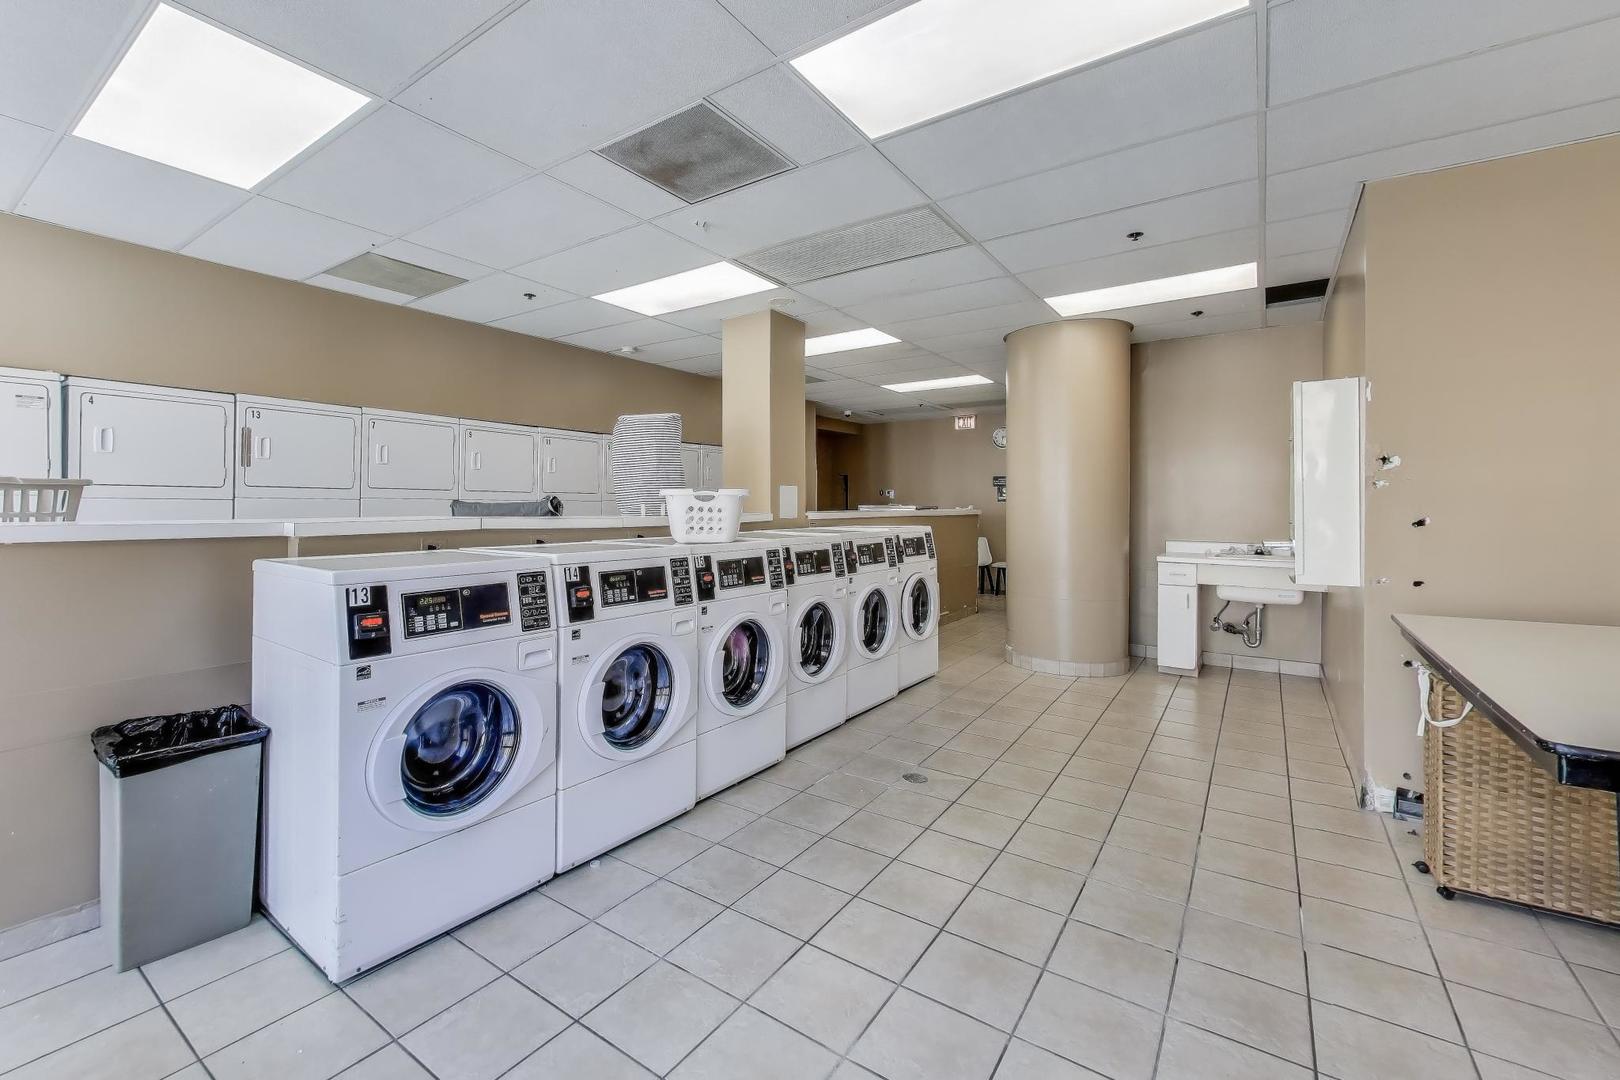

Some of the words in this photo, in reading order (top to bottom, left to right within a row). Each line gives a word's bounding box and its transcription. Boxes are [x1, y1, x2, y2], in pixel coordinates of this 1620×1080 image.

[88, 395, 94, 405] 4
[251, 410, 261, 419] 13
[370, 420, 376, 429] 7
[566, 567, 579, 581] 14
[351, 587, 370, 605] 13
